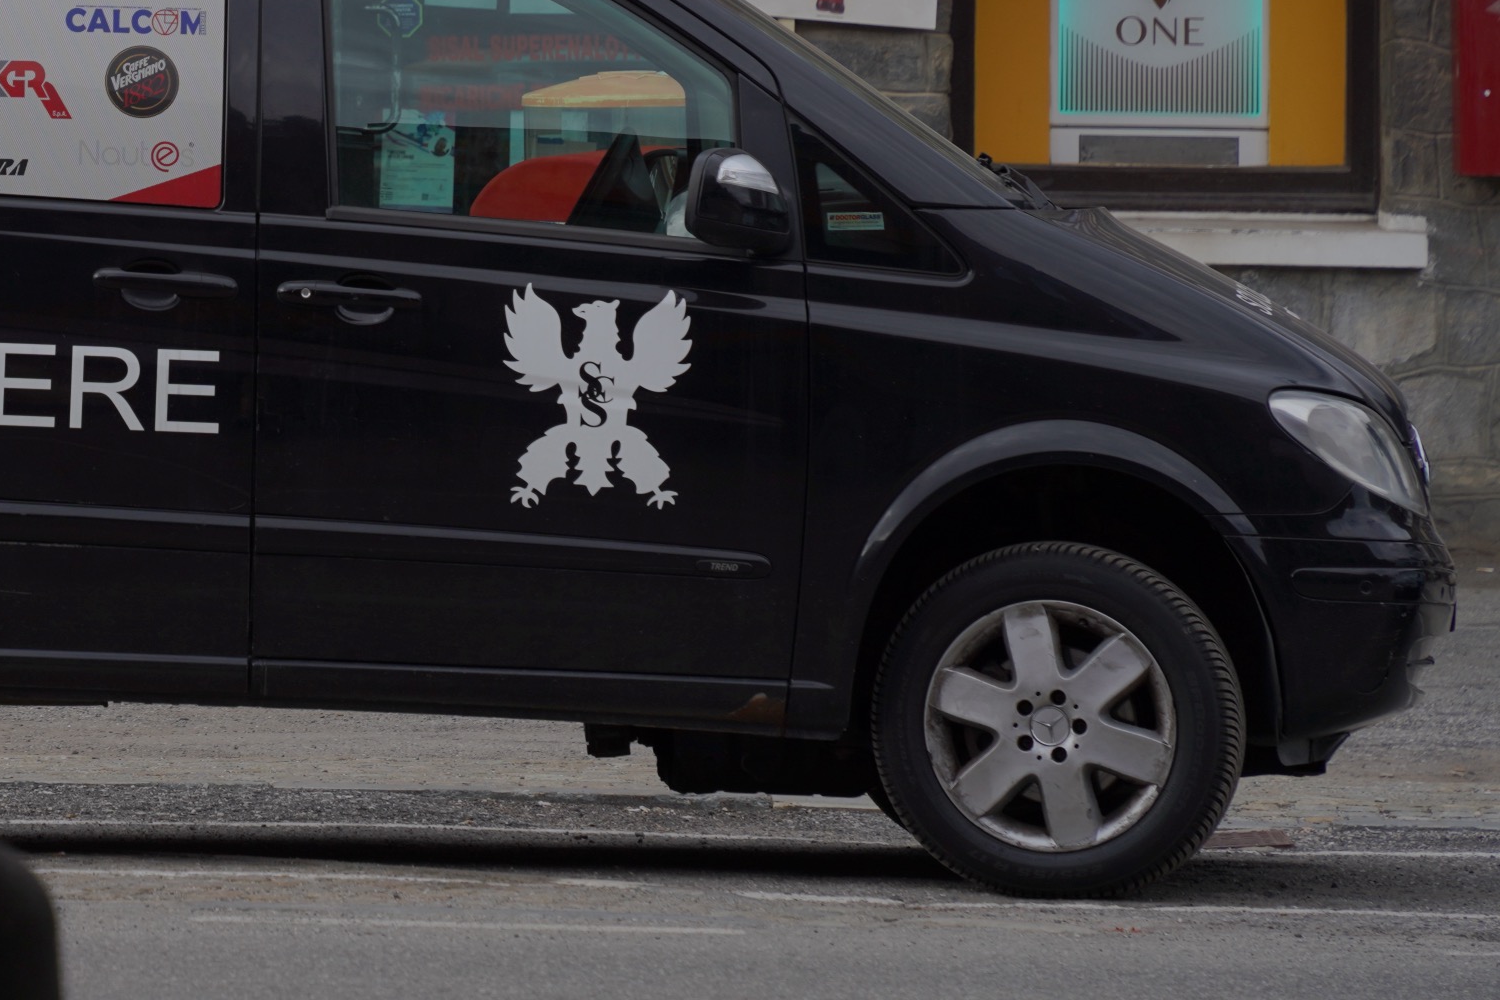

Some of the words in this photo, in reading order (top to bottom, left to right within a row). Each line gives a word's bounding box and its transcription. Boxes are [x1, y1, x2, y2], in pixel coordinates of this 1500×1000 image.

[1115, 15, 1204, 46] ONE
[111, 59, 167, 91] VERGNANO
[122, 74, 165, 107] 1882
[711, 562, 739, 572] TREND
